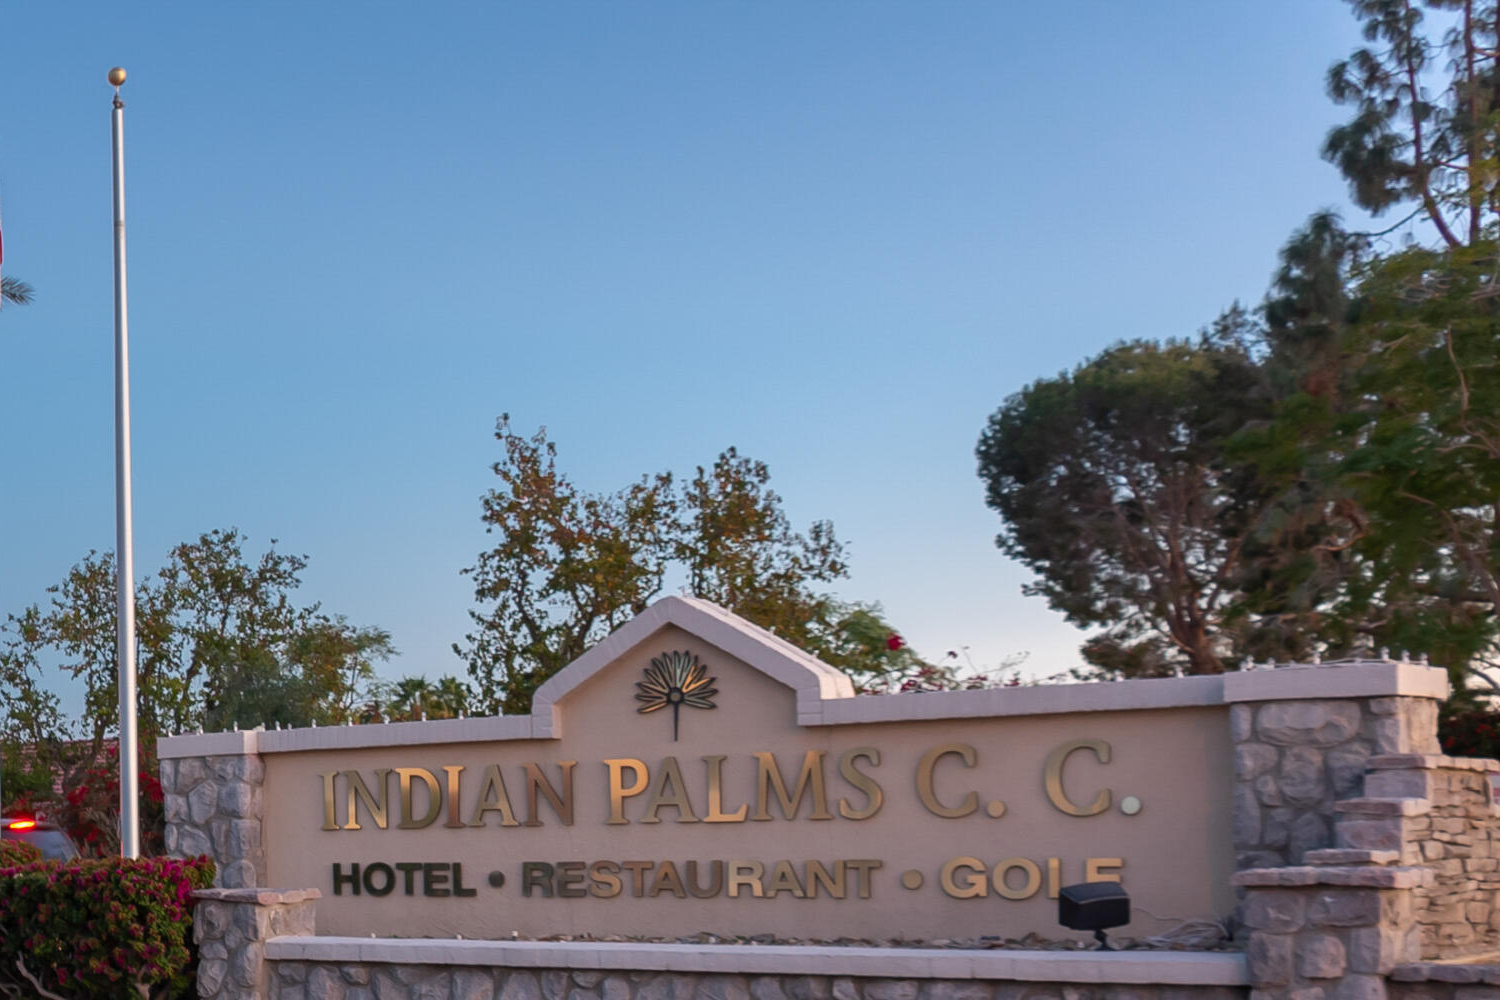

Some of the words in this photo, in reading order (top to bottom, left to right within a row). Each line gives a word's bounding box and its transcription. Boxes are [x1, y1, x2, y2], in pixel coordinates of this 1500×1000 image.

[320, 761, 578, 830] INDIAN
[604, 747, 884, 826] PALMS
[915, 743, 1007, 819] C.
[1045, 738, 1142, 817] C.
[332, 862, 477, 897] HOTEL
[522, 859, 882, 899] RESTAURANT
